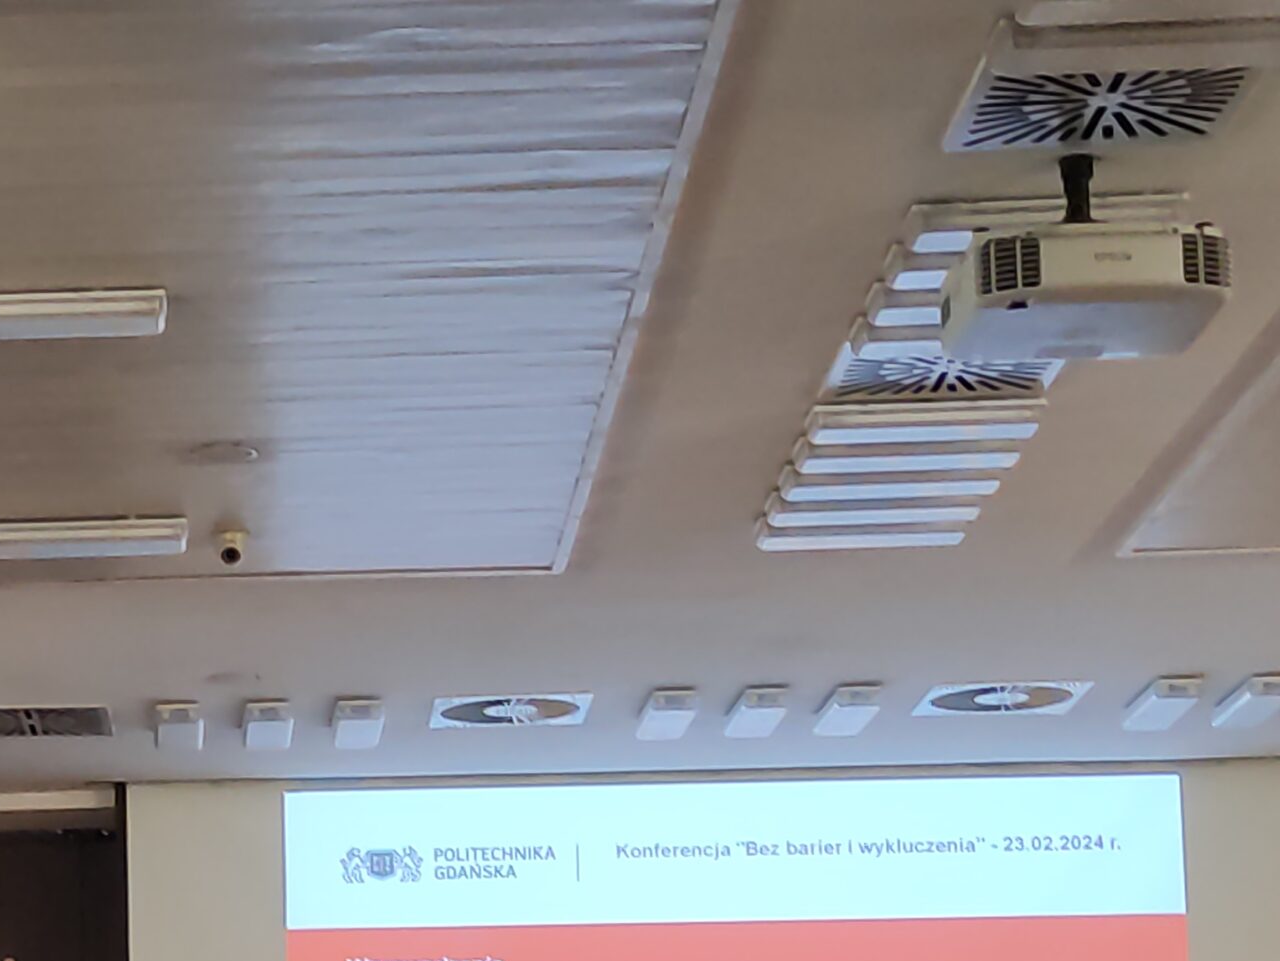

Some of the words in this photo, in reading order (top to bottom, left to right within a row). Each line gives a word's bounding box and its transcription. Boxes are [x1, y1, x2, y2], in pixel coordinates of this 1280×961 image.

[433, 846, 556, 862] POLITECHNIKA
[615, 842, 731, 861] Konferencja
[785, 839, 842, 856] barier
[1002, 834, 1104, 852] 23.02.2024
[1109, 837, 1121, 851] r.
[434, 863, 517, 880] GDAŃSKA
